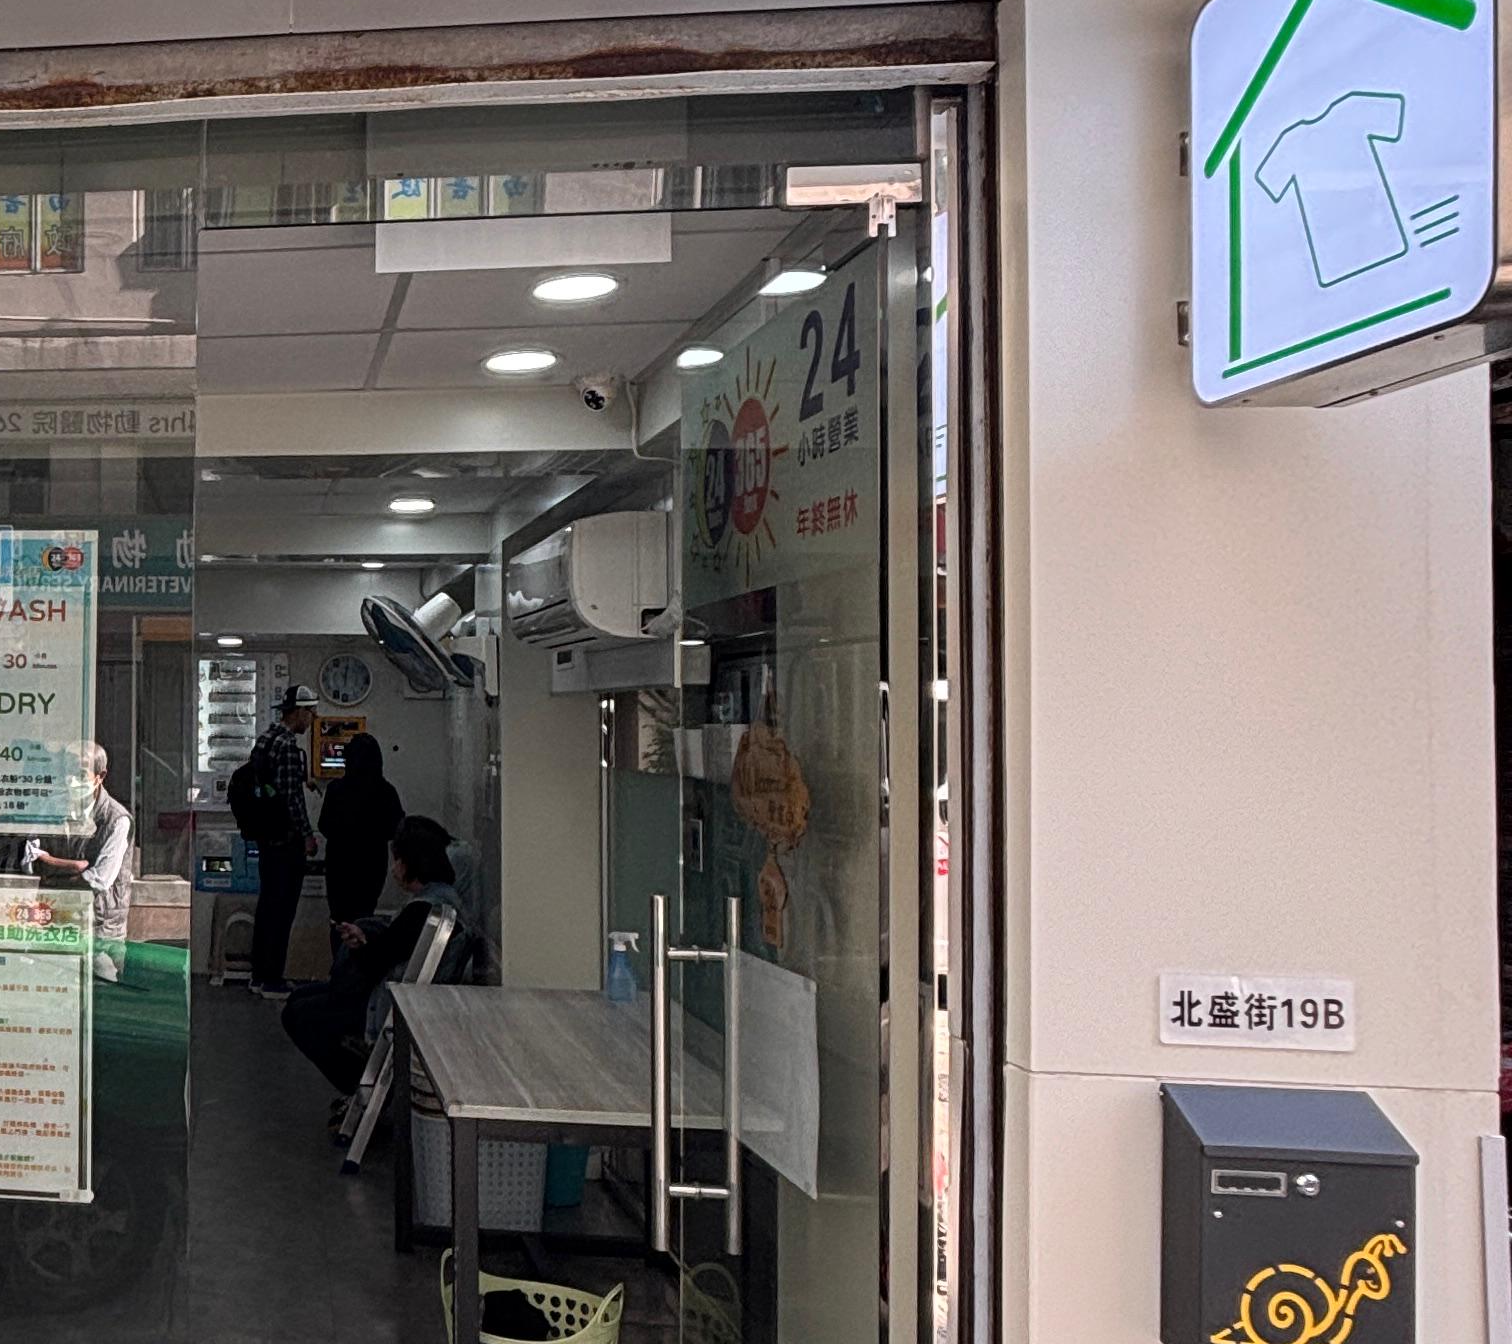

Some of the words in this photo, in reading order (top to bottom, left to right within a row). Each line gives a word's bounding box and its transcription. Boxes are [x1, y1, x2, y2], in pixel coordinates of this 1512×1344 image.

[798, 281, 862, 423] 24
[2, 653, 28, 670] 30
[1169, 989, 1347, 1032] 北盛街19B
